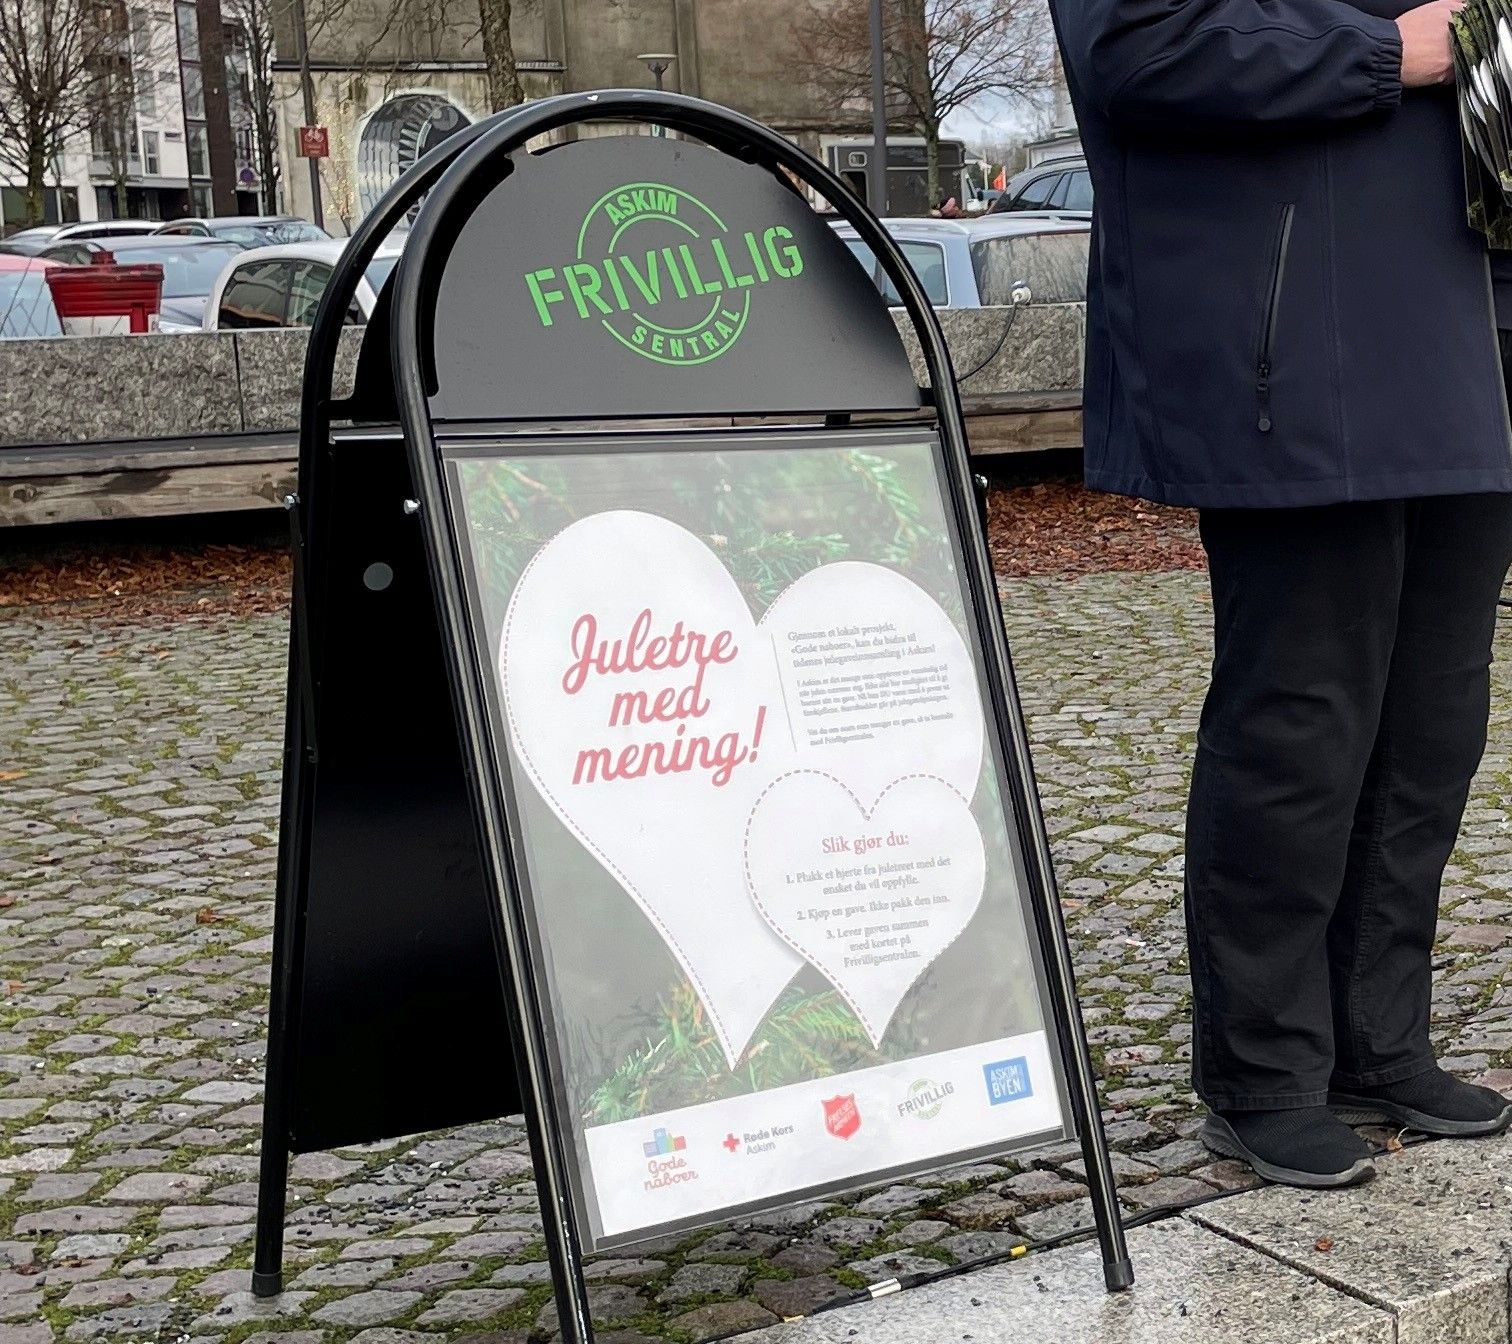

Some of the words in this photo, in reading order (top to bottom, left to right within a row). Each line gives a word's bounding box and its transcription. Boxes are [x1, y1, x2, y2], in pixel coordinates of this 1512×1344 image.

[604, 189, 678, 226] ASKIM
[525, 226, 804, 327] FRIVILLIG
[631, 308, 741, 358] SENTRAL
[562, 608, 739, 695] Juletre
[872, 636, 884, 646] du
[608, 664, 711, 727] med
[572, 705, 767, 787] mening!
[821, 835, 851, 854] Slik
[853, 834, 882, 855] gjør
[886, 831, 910, 847] du:
[796, 869, 824, 883] Plukk
[825, 869, 834, 879] et
[835, 866, 862, 880] hjerte
[864, 864, 876, 875] fra
[916, 857, 935, 870] med
[854, 880, 867, 891] du
[868, 878, 880, 889] vil
[832, 908, 843, 916] en
[869, 900, 889, 912] Ikke
[890, 897, 914, 912] pakk
[914, 895, 931, 906] den
[850, 939, 869, 952] med
[900, 934, 911, 947] på
[897, 1081, 954, 1117] FRIVILLIG
[992, 1078, 1022, 1098] BYEN
[743, 1130, 770, 1144] Røde
[771, 1124, 794, 1137] Kors
[746, 1141, 776, 1155] Askim
[648, 1156, 687, 1178] Gode
[643, 1170, 699, 1191] naboer
